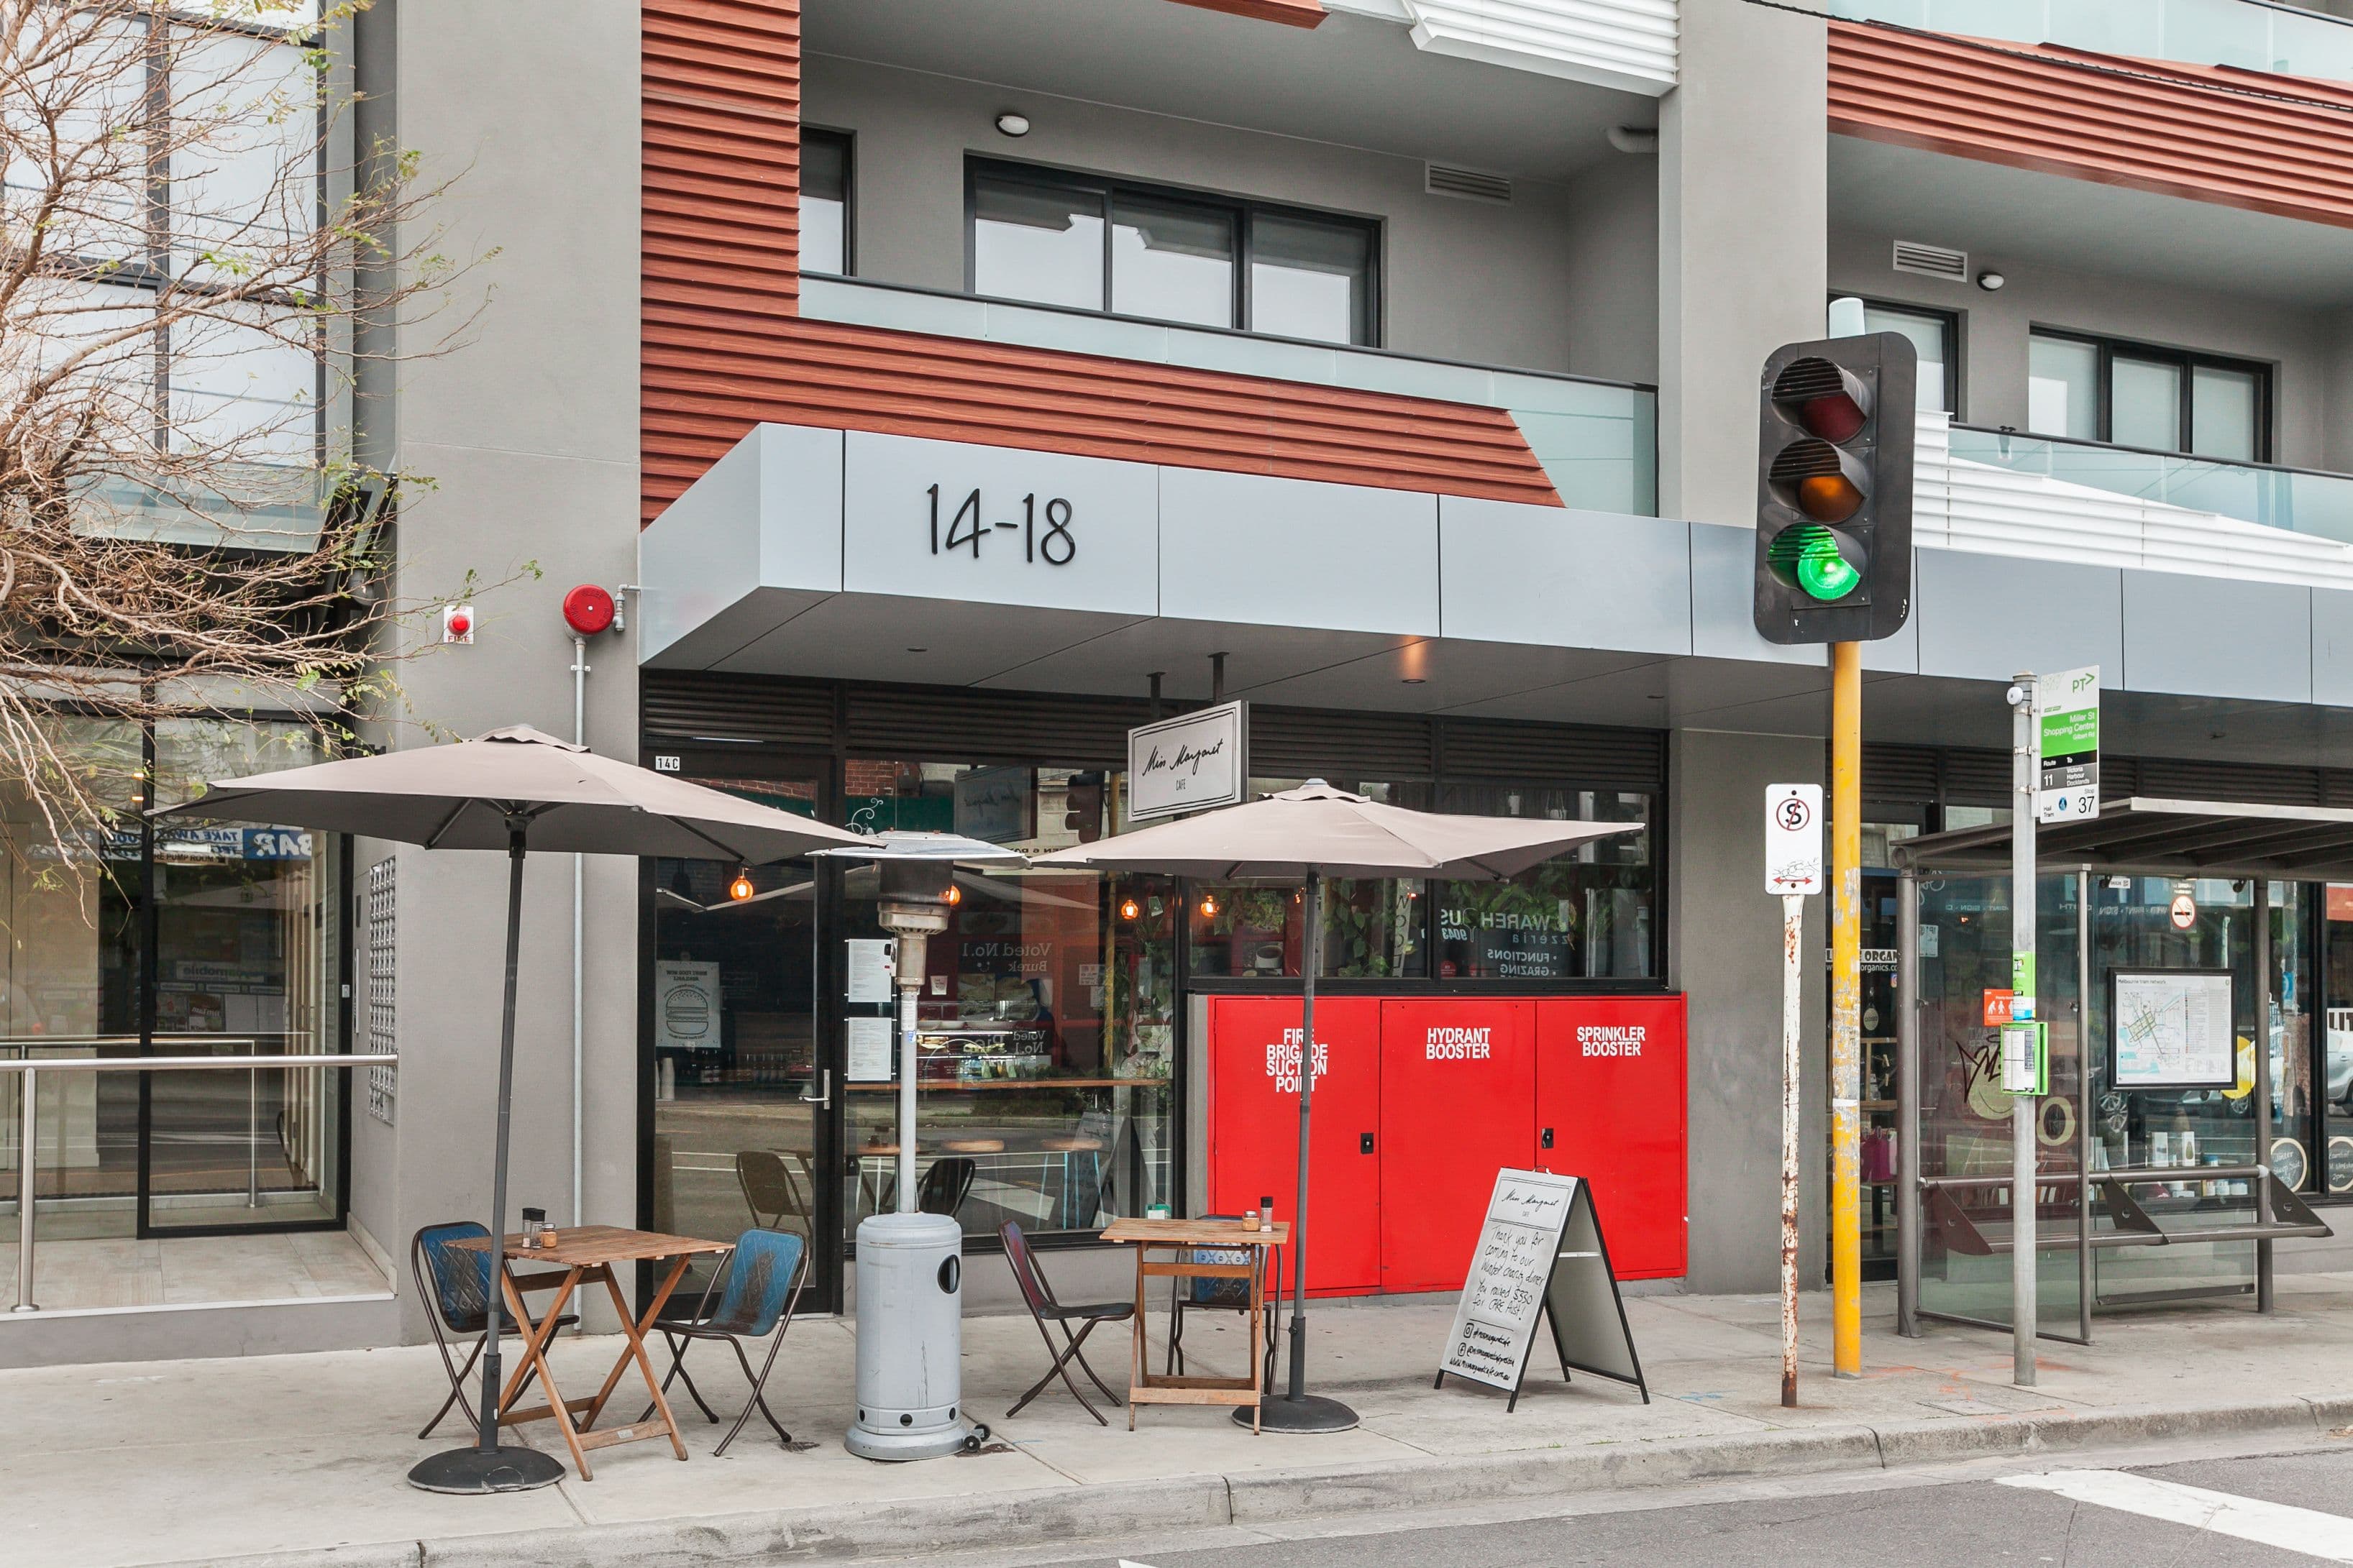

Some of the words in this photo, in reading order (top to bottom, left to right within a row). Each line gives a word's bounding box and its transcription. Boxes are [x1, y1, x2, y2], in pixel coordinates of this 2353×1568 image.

[927, 483, 1076, 565] 14-18
[2070, 714, 2086, 723] Miller
[2088, 712, 2095, 720] St
[2044, 726, 2073, 737] Shopping
[2074, 723, 2095, 732] Centre
[658, 758, 678, 769] 14C
[1176, 779, 1186, 791] CAFE
[2044, 774, 2053, 787] 11
[2078, 796, 2095, 813] 37
[1427, 1027, 1491, 1044] HYDRANT
[1577, 1026, 1645, 1042] SPRINKLER
[1266, 1044, 1328, 1060] BRIGDE
[1426, 1042, 1490, 1060] BOOSTER
[1582, 1041, 1641, 1057] BOOSTER
[1266, 1059, 1327, 1076] SUCTON
[1491, 1225, 1512, 1246] Thank
[1513, 1236, 1527, 1252] you
[1531, 1232, 1544, 1250] for
[1485, 1244, 1508, 1268] coming
[1511, 1252, 1518, 1261] to
[1520, 1257, 1535, 1266] our
[1477, 1278, 1486, 1294] You
[1491, 1285, 1512, 1298] raised
[1473, 1293, 1485, 1311] for
